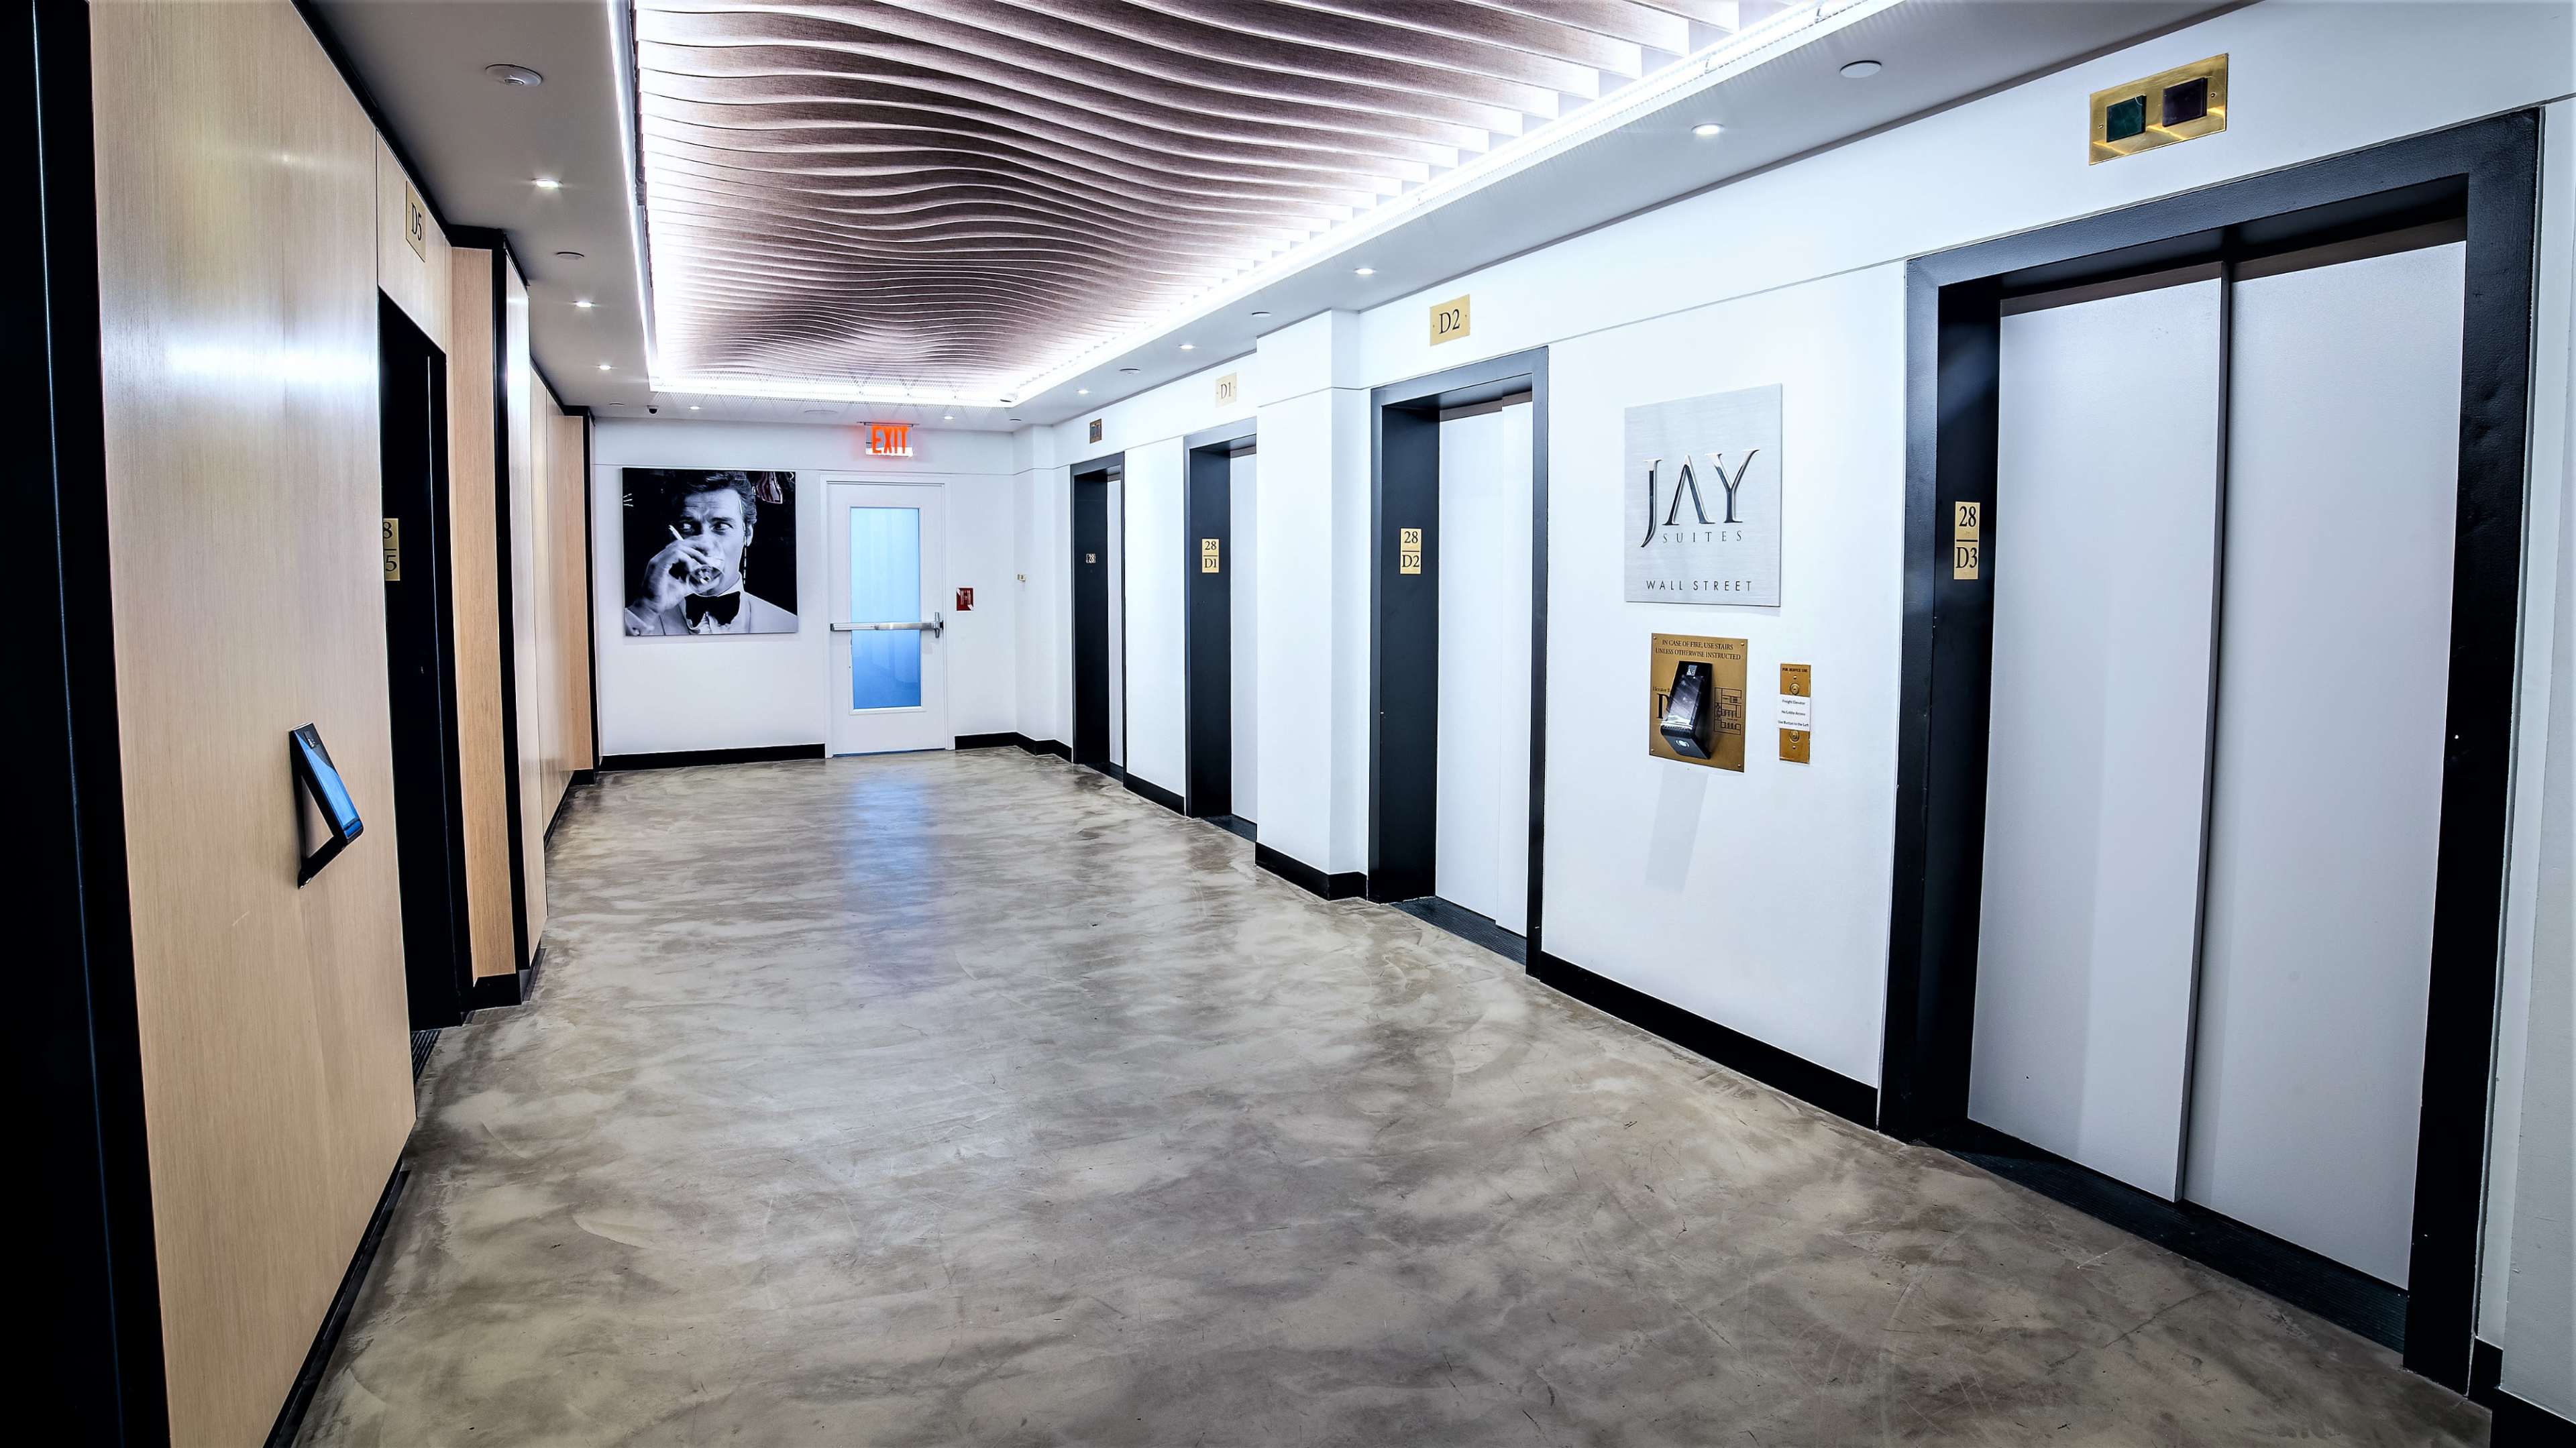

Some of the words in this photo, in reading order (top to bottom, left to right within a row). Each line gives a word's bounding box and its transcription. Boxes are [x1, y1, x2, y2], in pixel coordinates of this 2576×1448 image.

[411, 202, 422, 241] D5
[1439, 309, 1460, 334] D2
[1220, 382, 1232, 399] D1
[871, 424, 908, 454] EXIT
[1640, 449, 1760, 548] JAY
[1959, 506, 1976, 527] 28
[383, 521, 393, 539] 8
[1404, 531, 1419, 544] 28
[1662, 530, 1743, 544] SUITES
[1205, 541, 1217, 551] 28
[386, 555, 397, 571] 5
[1204, 558, 1217, 568] D1
[1401, 555, 1419, 568] D2
[1955, 547, 1978, 569] D3
[1646, 579, 1683, 591] WALL
[1693, 580, 1752, 592] STREET
[1674, 649, 1705, 657] OTHERWISE
[1705, 651, 1741, 660] INSTRUCTED
